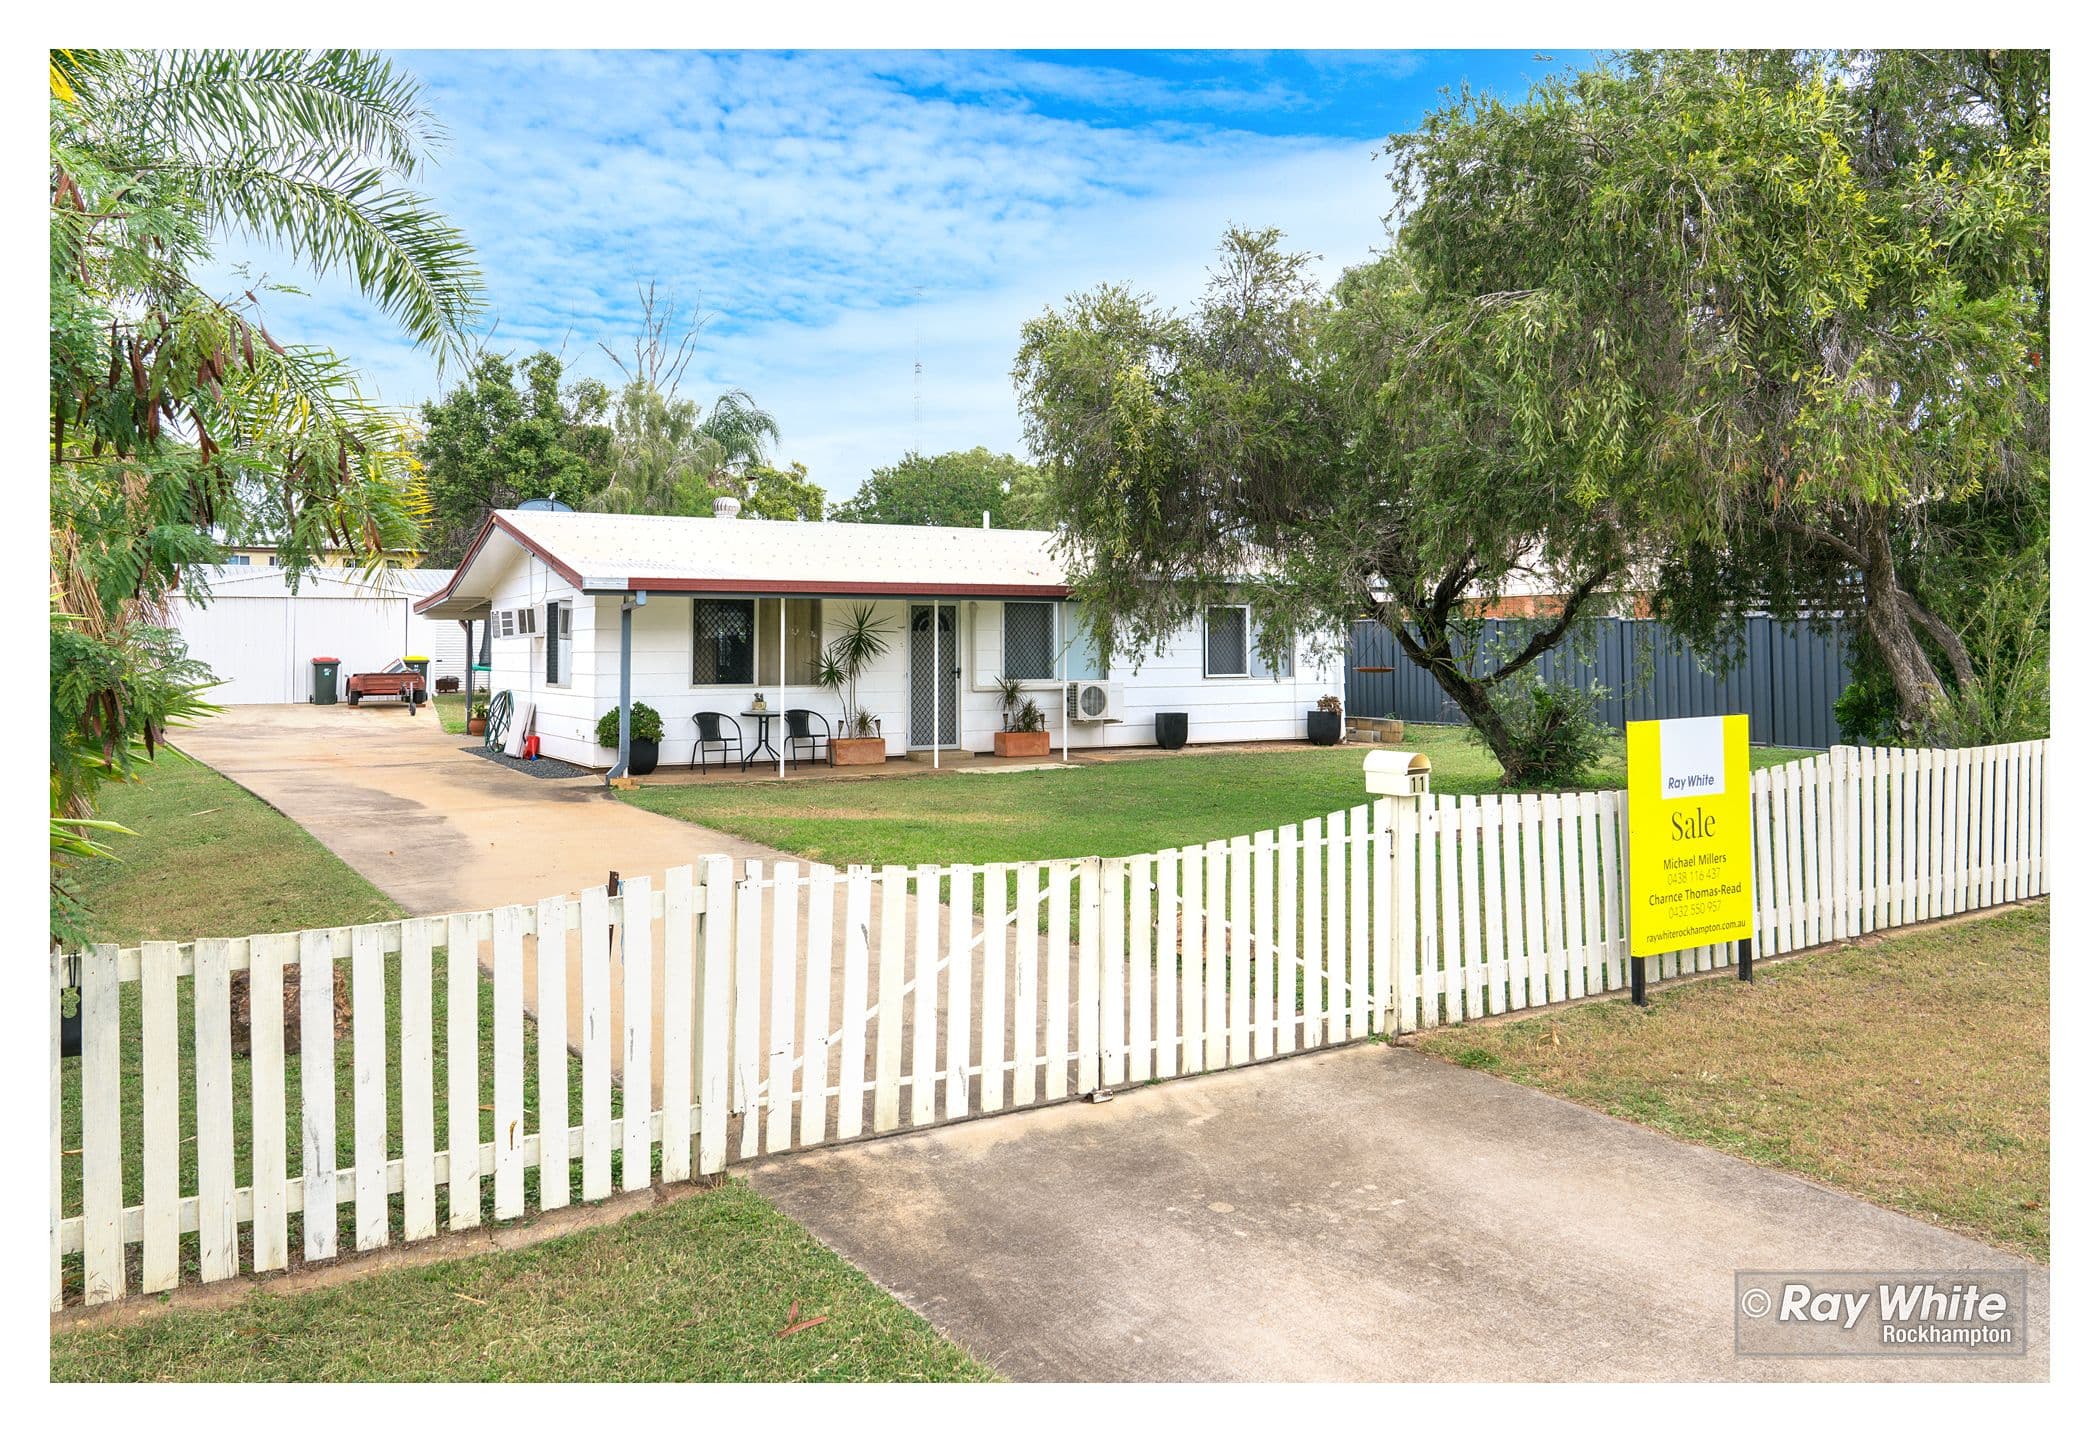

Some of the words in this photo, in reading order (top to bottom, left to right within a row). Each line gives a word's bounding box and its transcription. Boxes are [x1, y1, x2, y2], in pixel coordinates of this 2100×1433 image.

[1411, 776, 1424, 792] 11
[1668, 777, 1687, 790] Ray
[1687, 774, 1715, 787] White
[1671, 807, 1716, 842] Sale
[1663, 854, 1696, 870] Michael
[1698, 852, 1727, 866] Millers
[1667, 871, 1687, 886] 0438
[1690, 869, 1705, 881] 116
[1706, 867, 1721, 880] 437
[1648, 892, 1683, 906] Charnce
[1685, 882, 1742, 900] Thomas-Read
[1668, 904, 1689, 919] 0432
[1706, 900, 1722, 913] 957
[1646, 920, 1746, 943] raywhiterockhampton.com.au
